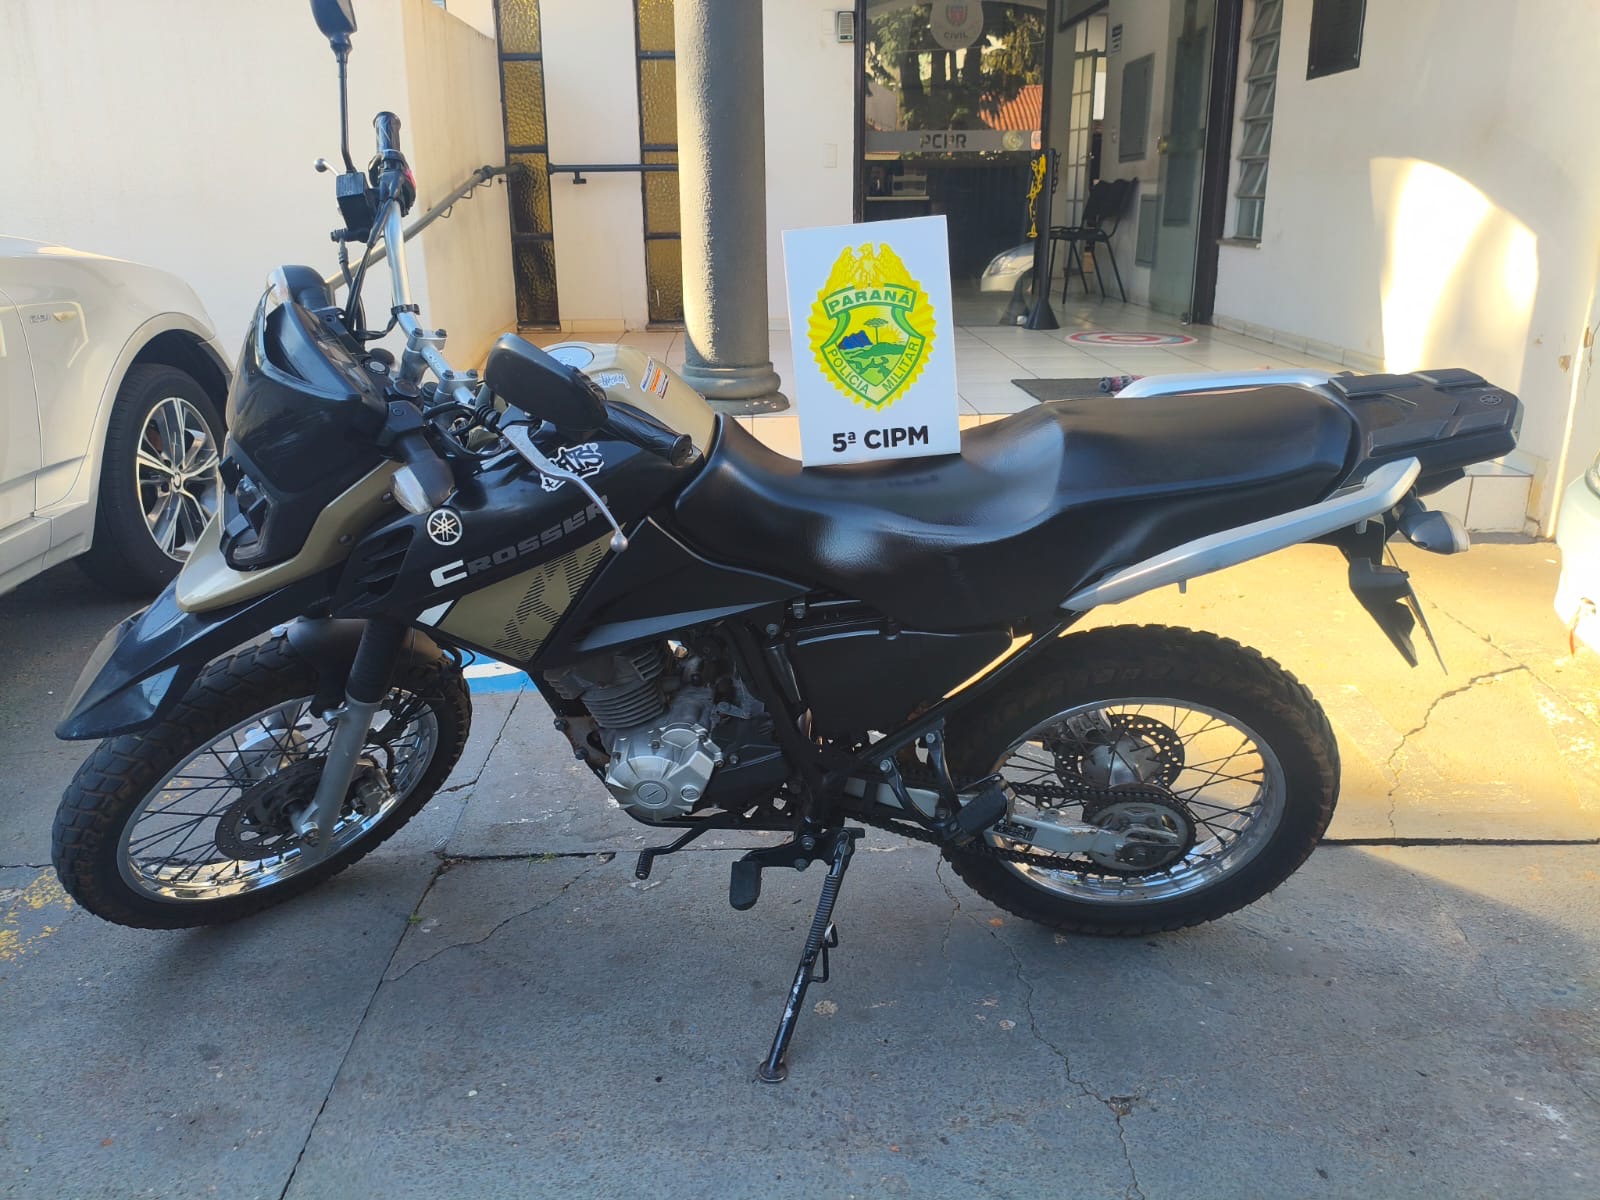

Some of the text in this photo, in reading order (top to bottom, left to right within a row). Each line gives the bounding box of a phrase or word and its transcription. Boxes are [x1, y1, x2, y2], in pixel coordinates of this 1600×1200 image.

[920, 134, 967, 149] PCPR
[828, 289, 911, 313] PARANÁ
[883, 341, 919, 392] MILITAR
[864, 425, 929, 449] CIPM
